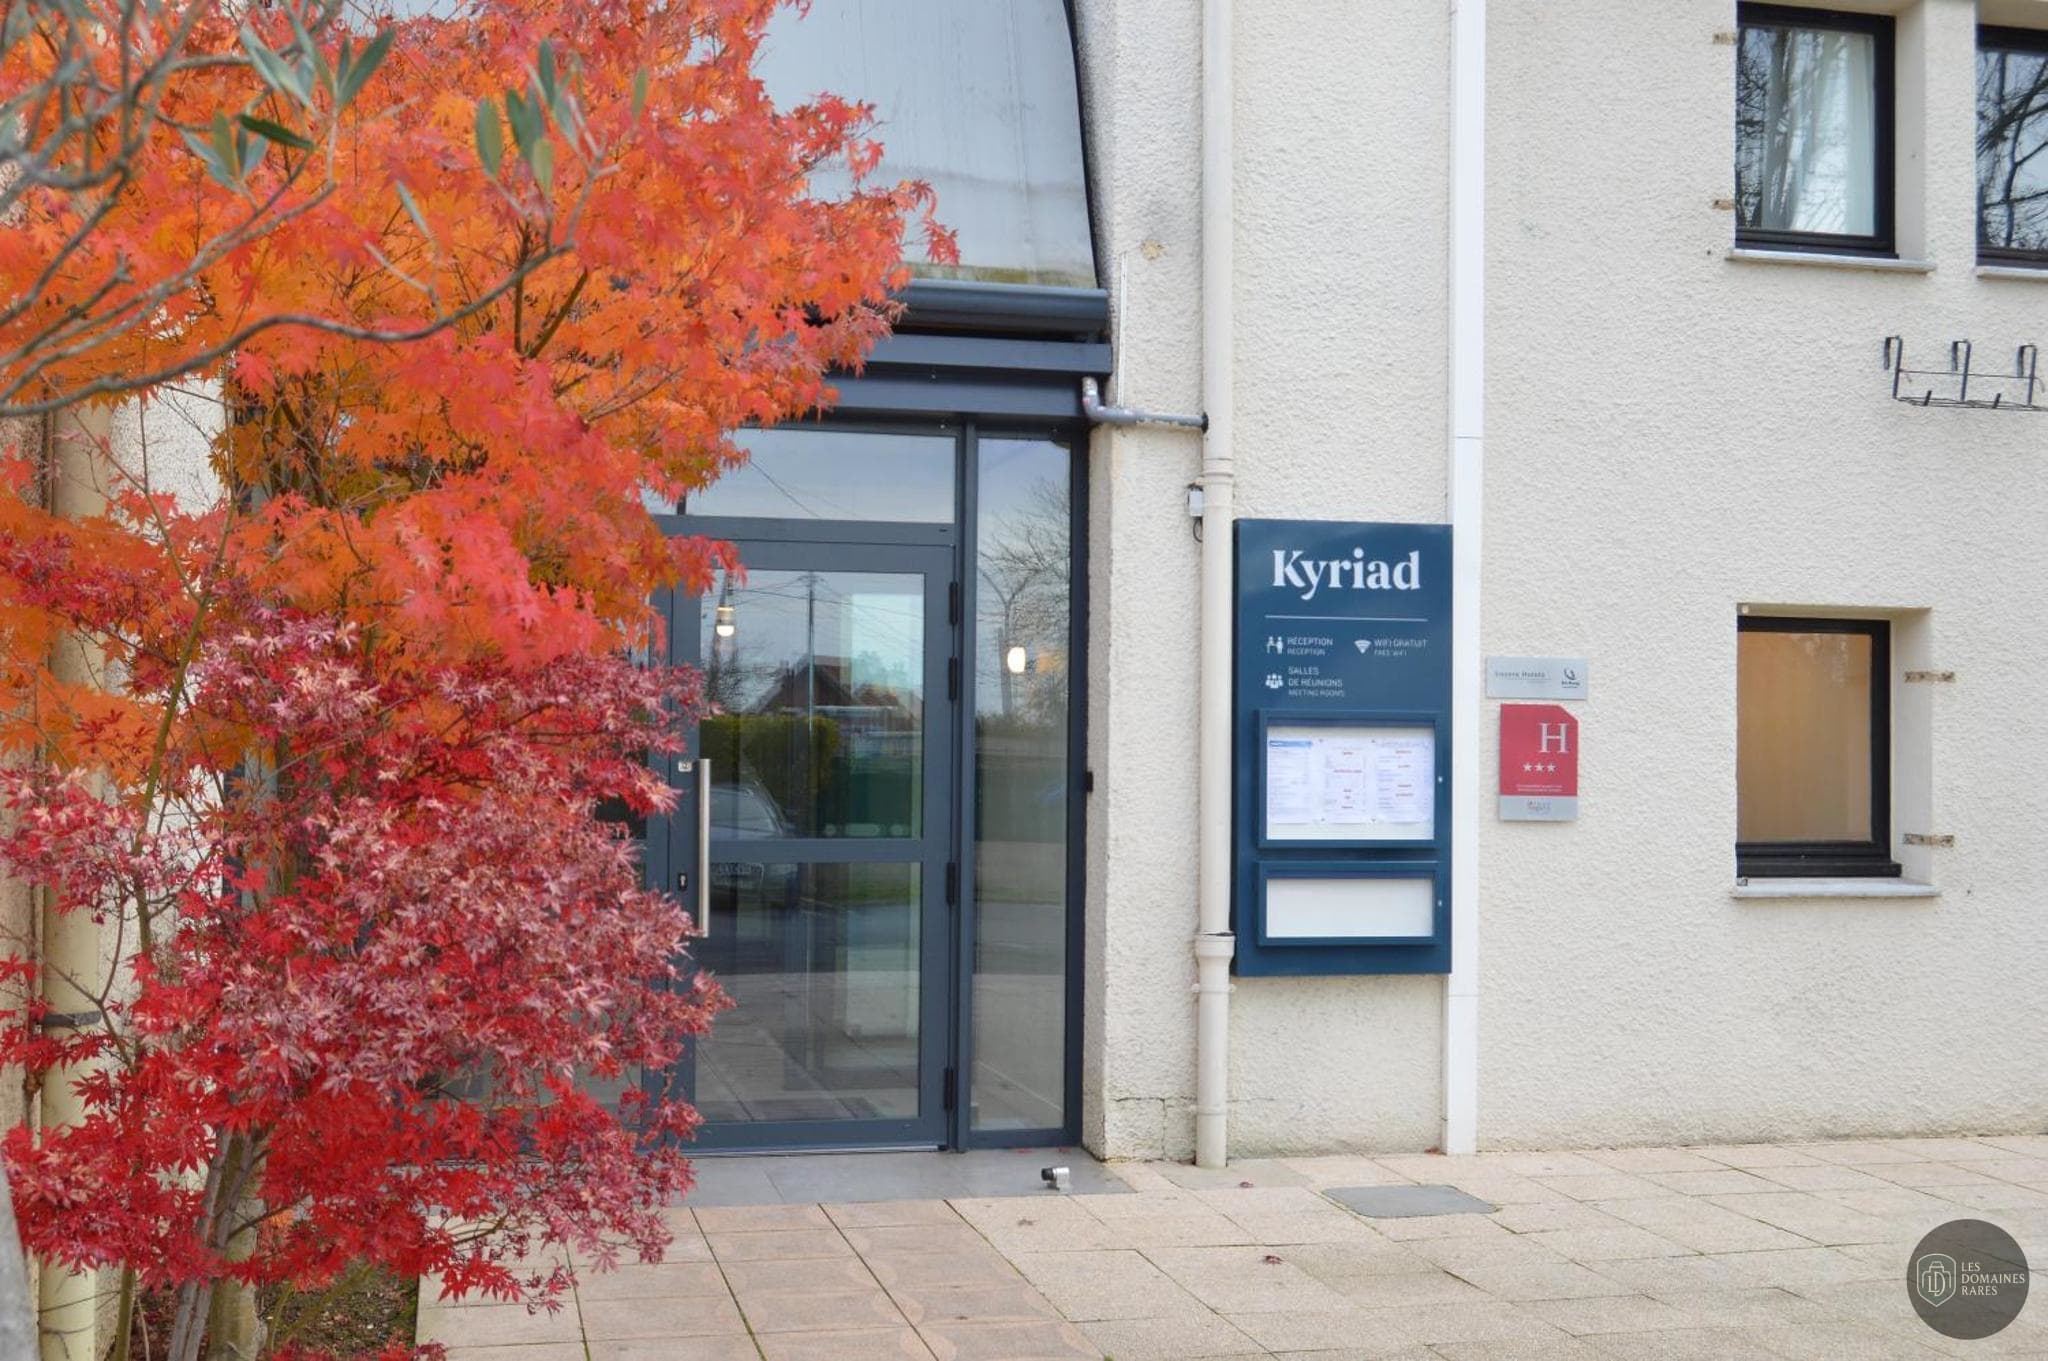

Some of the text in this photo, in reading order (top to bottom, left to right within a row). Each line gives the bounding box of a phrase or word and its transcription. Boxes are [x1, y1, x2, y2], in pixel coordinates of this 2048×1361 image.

[1272, 547, 1421, 601] Kyriad
[1288, 666, 1320, 676] SALLES
[1288, 678, 1300, 687] DE
[1538, 722, 1569, 754] H
